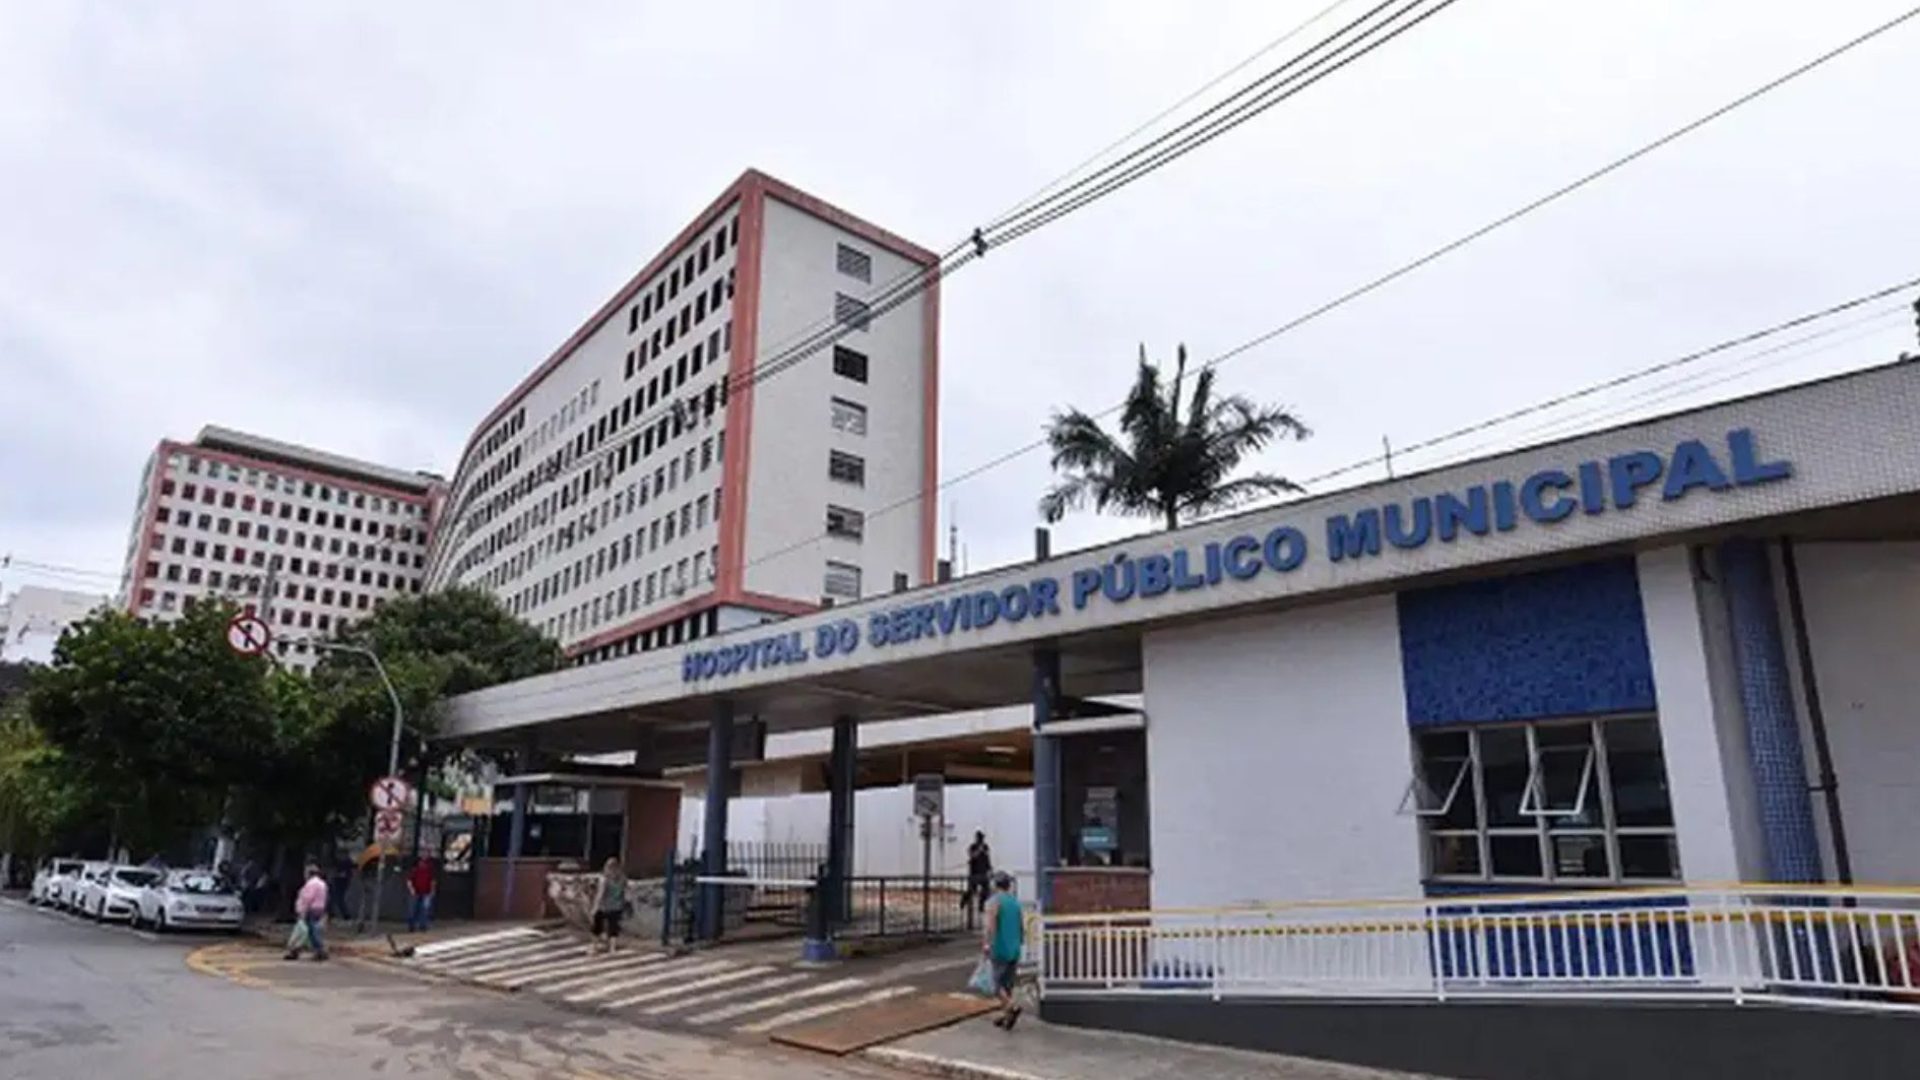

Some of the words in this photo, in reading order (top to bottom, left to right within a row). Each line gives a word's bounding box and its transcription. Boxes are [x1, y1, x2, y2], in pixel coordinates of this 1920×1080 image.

[682, 629, 808, 682] HOSPITAL
[815, 616, 860, 660] DO
[872, 575, 1060, 649] SERVIDOR
[1072, 526, 1308, 608] PÚBLICO
[1326, 428, 1792, 562] MUNICIPAL
